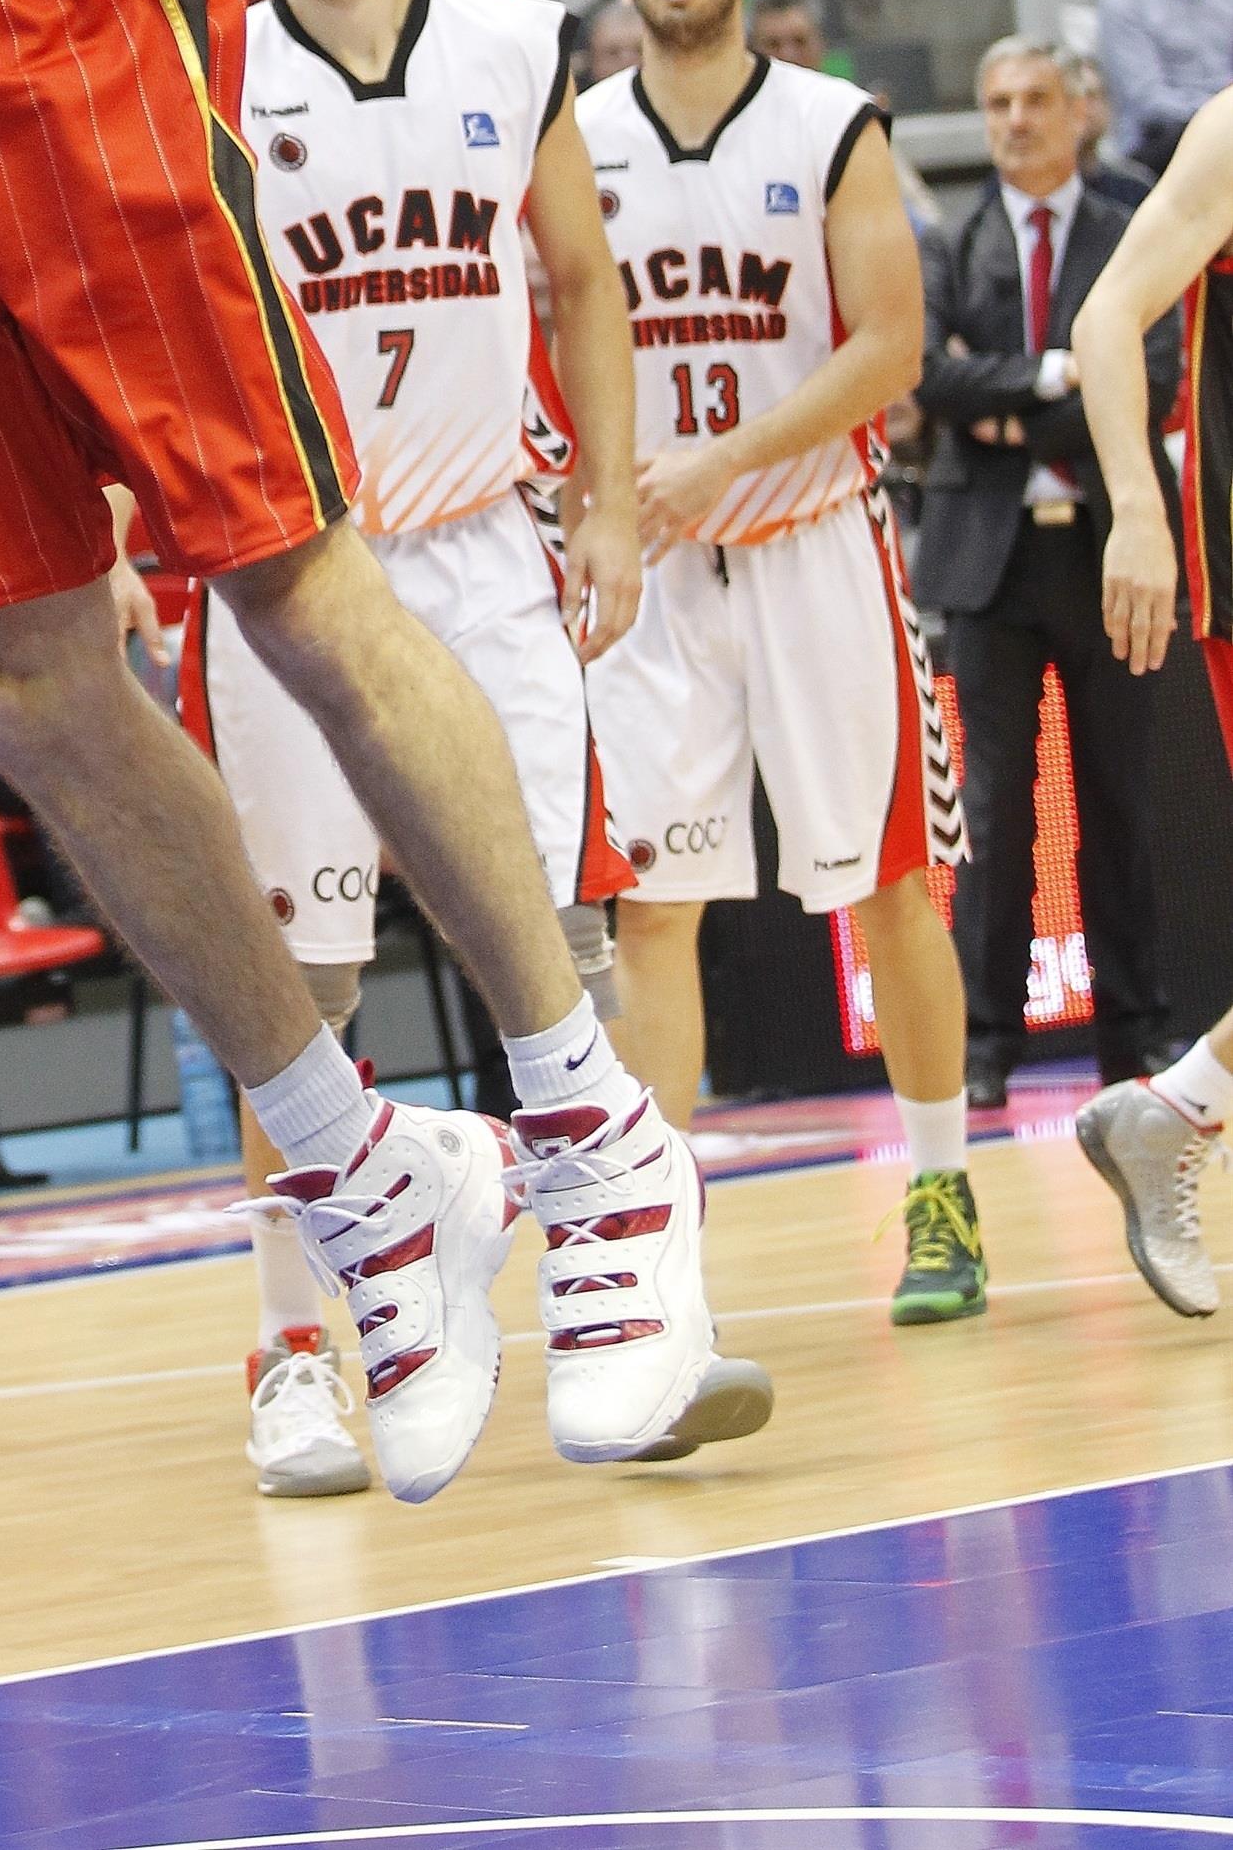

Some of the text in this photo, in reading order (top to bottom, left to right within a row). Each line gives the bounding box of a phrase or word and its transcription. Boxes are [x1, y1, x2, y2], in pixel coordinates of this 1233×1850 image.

[283, 188, 499, 275] UCAM
[376, 328, 415, 410] 7
[671, 361, 741, 438] 13
